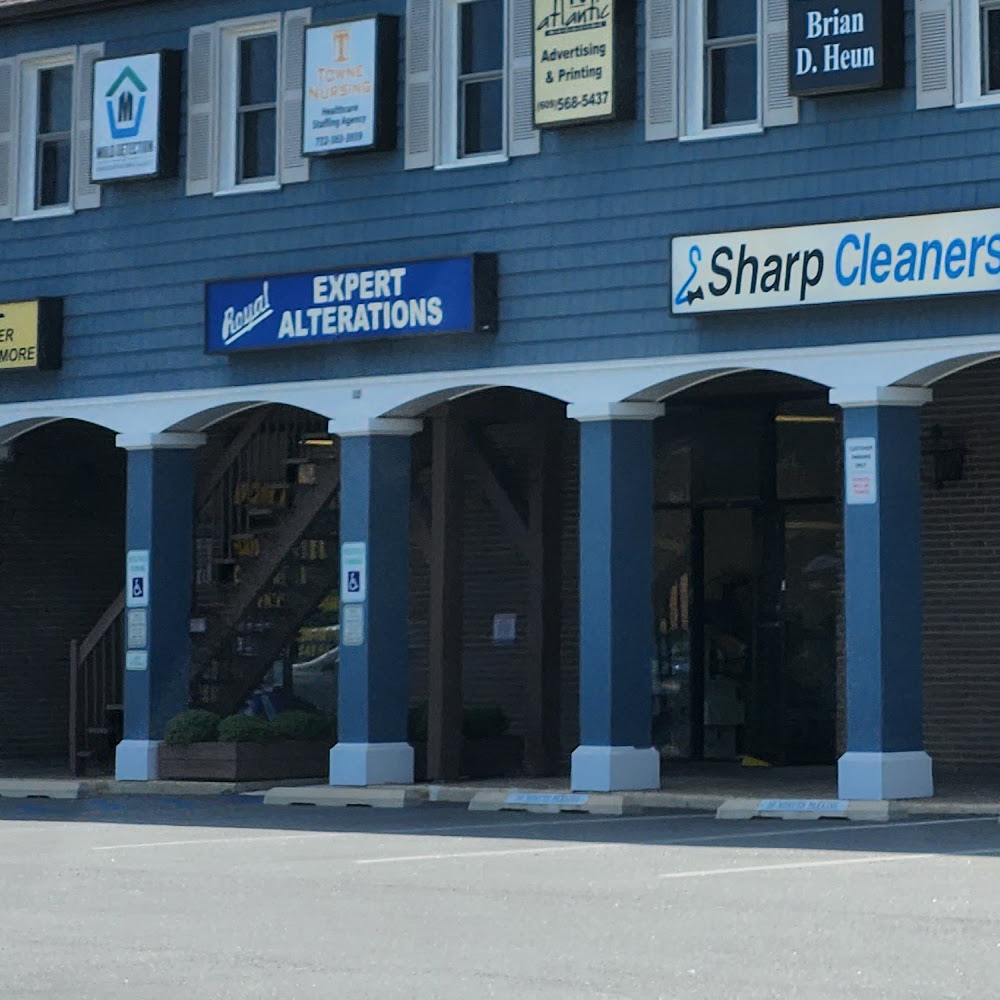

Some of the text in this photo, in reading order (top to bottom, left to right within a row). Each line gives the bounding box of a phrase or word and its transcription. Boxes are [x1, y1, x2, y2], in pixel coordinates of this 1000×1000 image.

[806, 8, 865, 39] Brian
[541, 43, 606, 63] Advertising
[795, 43, 875, 76] D. Heun
[545, 65, 603, 84] & Printing
[313, 267, 407, 304] EXPERT
[708, 244, 825, 301] Sharp
[277, 296, 443, 339] ALTERATIONS
